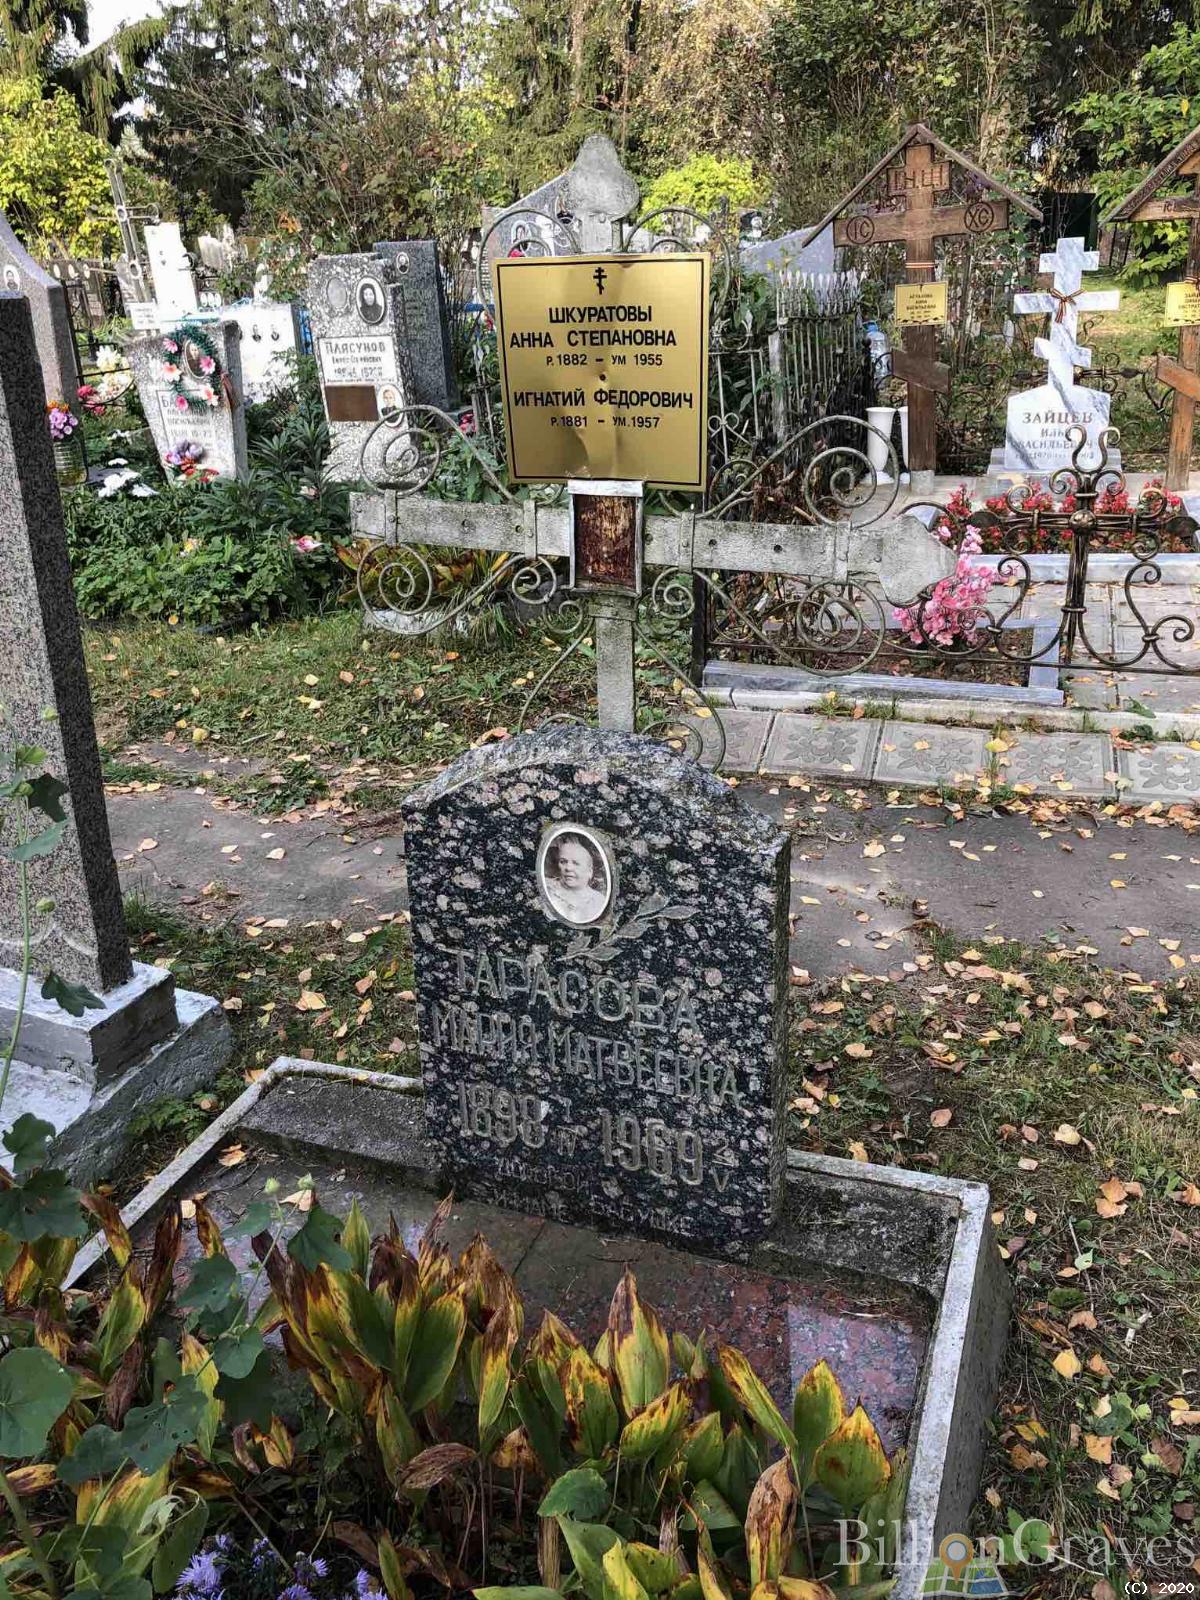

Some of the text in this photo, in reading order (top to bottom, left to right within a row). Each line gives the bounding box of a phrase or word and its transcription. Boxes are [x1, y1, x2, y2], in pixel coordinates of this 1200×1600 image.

[548, 305, 652, 324] ШКУРАТОВЫ
[509, 329, 677, 349] АННА СТЕПАНОВНА
[611, 354, 626, 365] УМ
[634, 353, 663, 366] 1955
[513, 387, 693, 409] ИГНАТИЙ ФЕДОРОВИЧ
[1022, 409, 1093, 424] ЗАЙЦЕВ
[438, 946, 702, 1032] ТАРАСОВА
[548, 1024, 742, 1105] МАТВЕЕВНА
[600, 1110, 703, 1186] 1969
